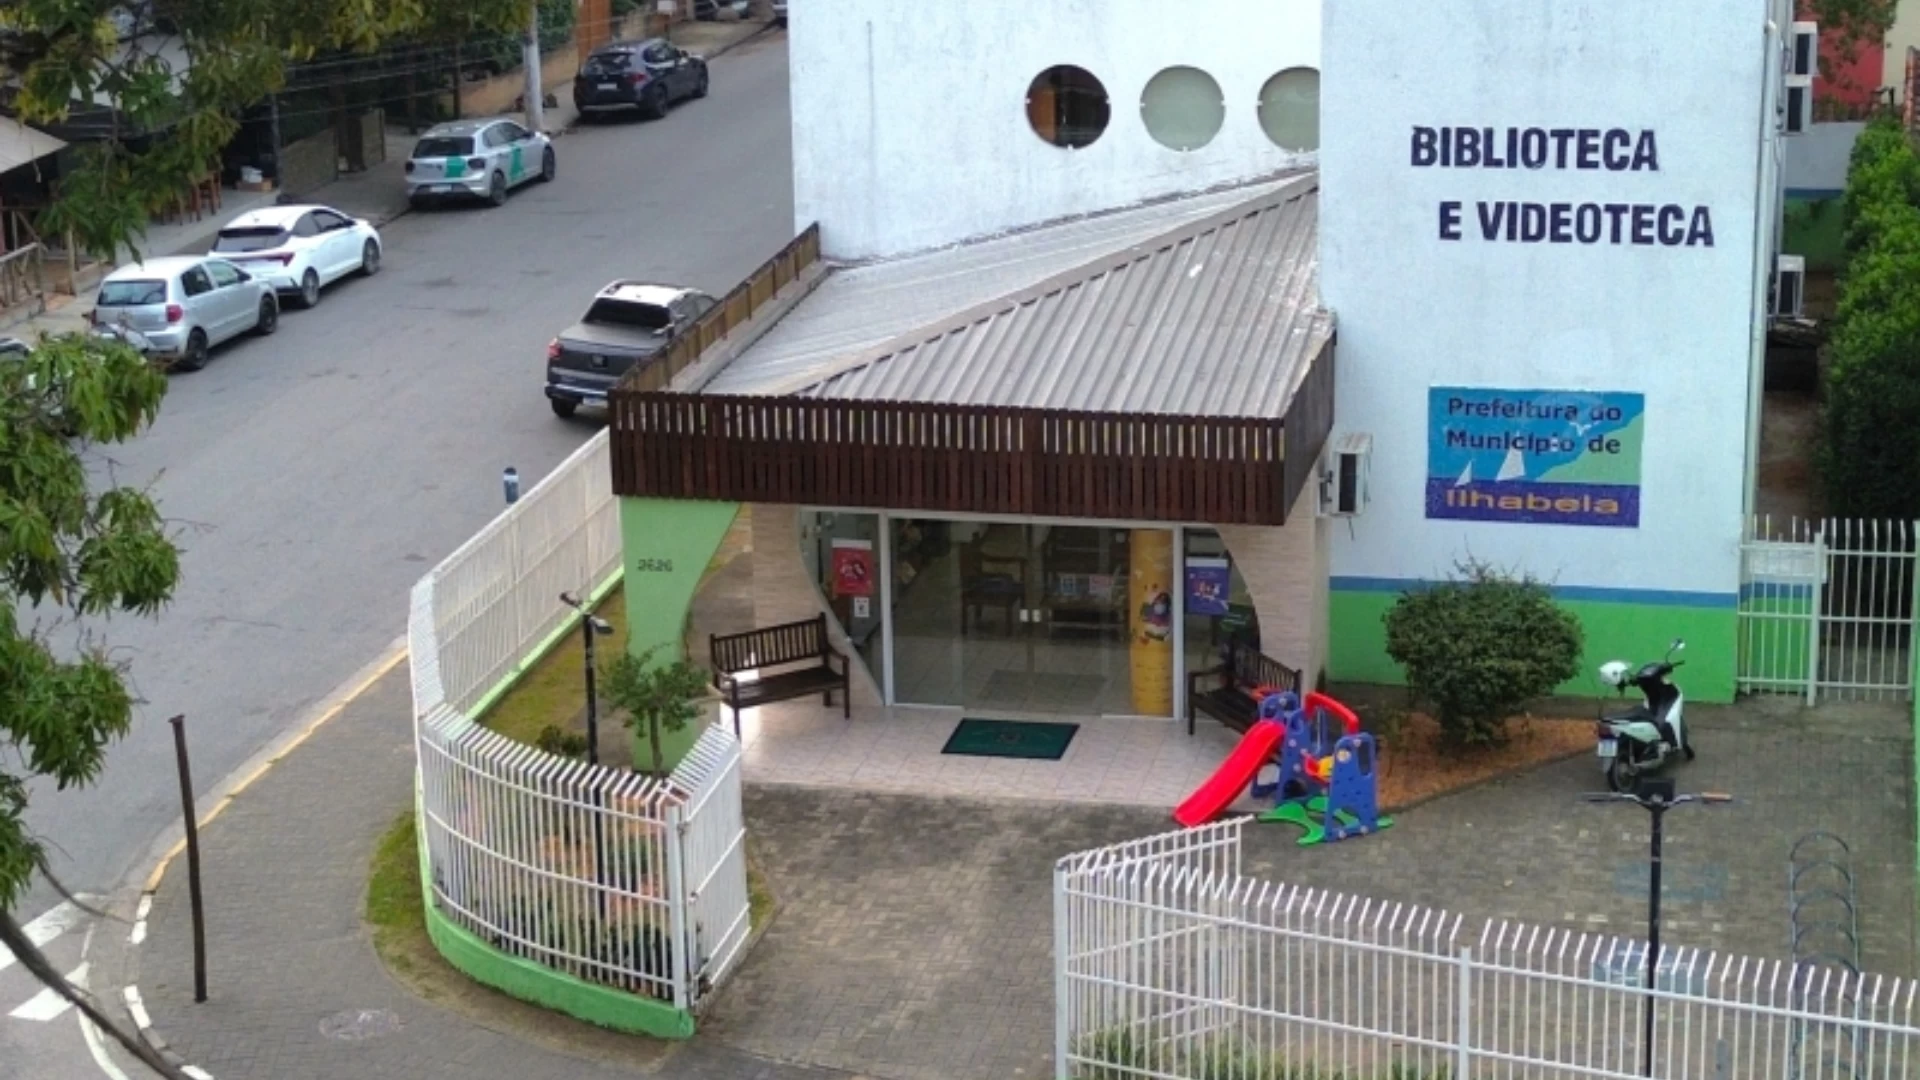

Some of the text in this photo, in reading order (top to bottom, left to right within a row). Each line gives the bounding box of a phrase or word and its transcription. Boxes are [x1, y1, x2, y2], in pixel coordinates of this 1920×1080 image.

[1410, 126, 1659, 171] BIBLIOTECA
[1439, 201, 1714, 247] E VIDEOTECA
[1447, 397, 1578, 421] Prefeitura
[1588, 434, 1621, 453] de
